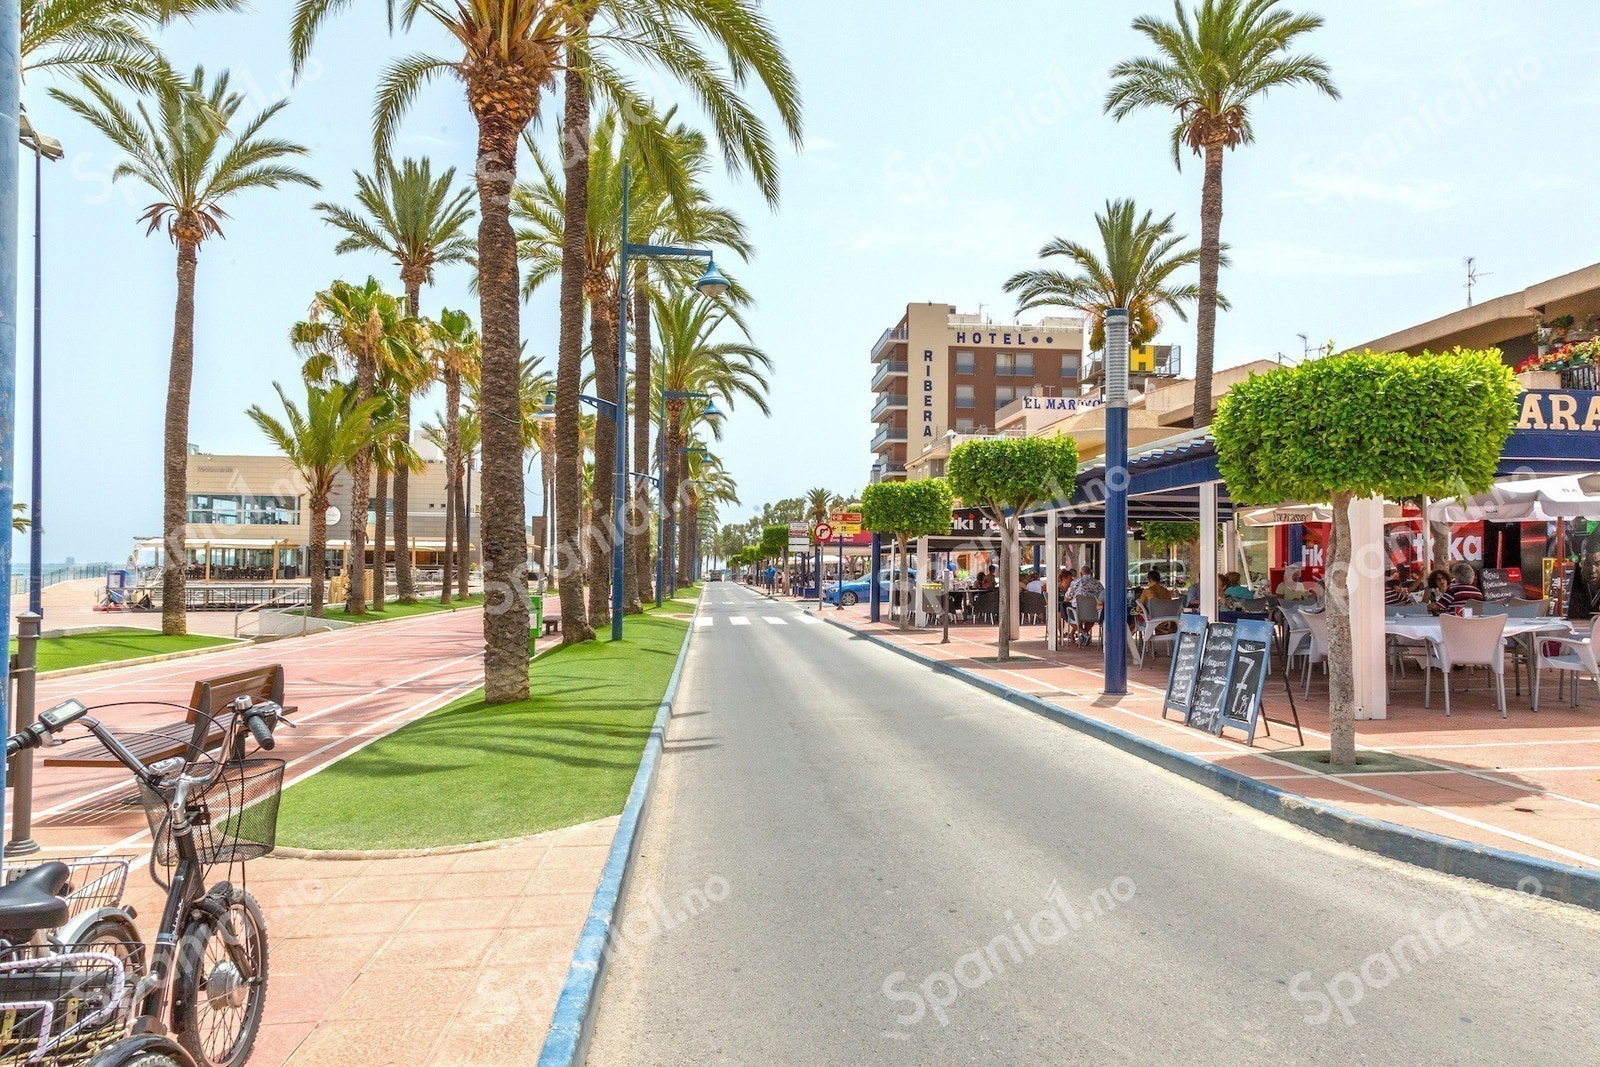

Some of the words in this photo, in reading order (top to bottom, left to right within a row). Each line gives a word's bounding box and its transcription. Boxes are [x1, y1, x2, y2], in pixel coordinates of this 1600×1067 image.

[956, 331, 1026, 345] HOTEL
[923, 349, 933, 438] RIBERA
[1024, 396, 1041, 409] EL
[950, 513, 974, 531] iki
